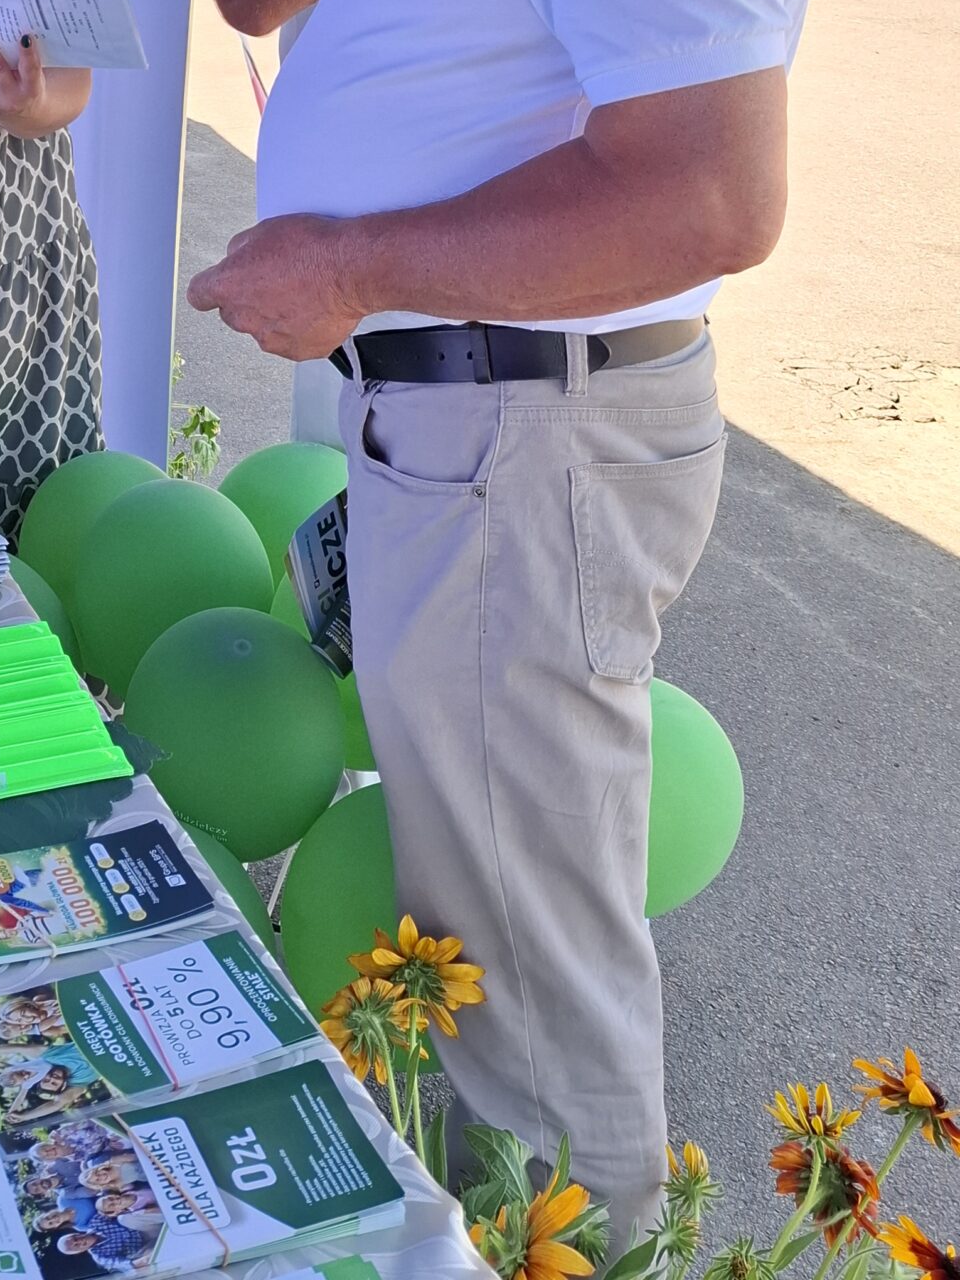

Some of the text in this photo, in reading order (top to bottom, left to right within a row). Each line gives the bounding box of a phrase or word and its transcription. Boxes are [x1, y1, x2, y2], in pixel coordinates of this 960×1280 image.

[52, 866, 83, 896] 000
[70, 898, 101, 928] 100
[154, 985, 202, 1040] DO 5 LAT
[166, 957, 251, 1049] 9,90 %
[223, 956, 278, 1022] OPROCENTOWANIE
[76, 1020, 105, 1056] KREDYT
[88, 983, 153, 1077] NA DOWOLNY CEL KONSUMENCKI
[150, 1010, 195, 1066] PROWIZJA
[163, 1127, 220, 1221] DLA KAŻDEGO
[226, 1127, 277, 1191] 0ZŁ
